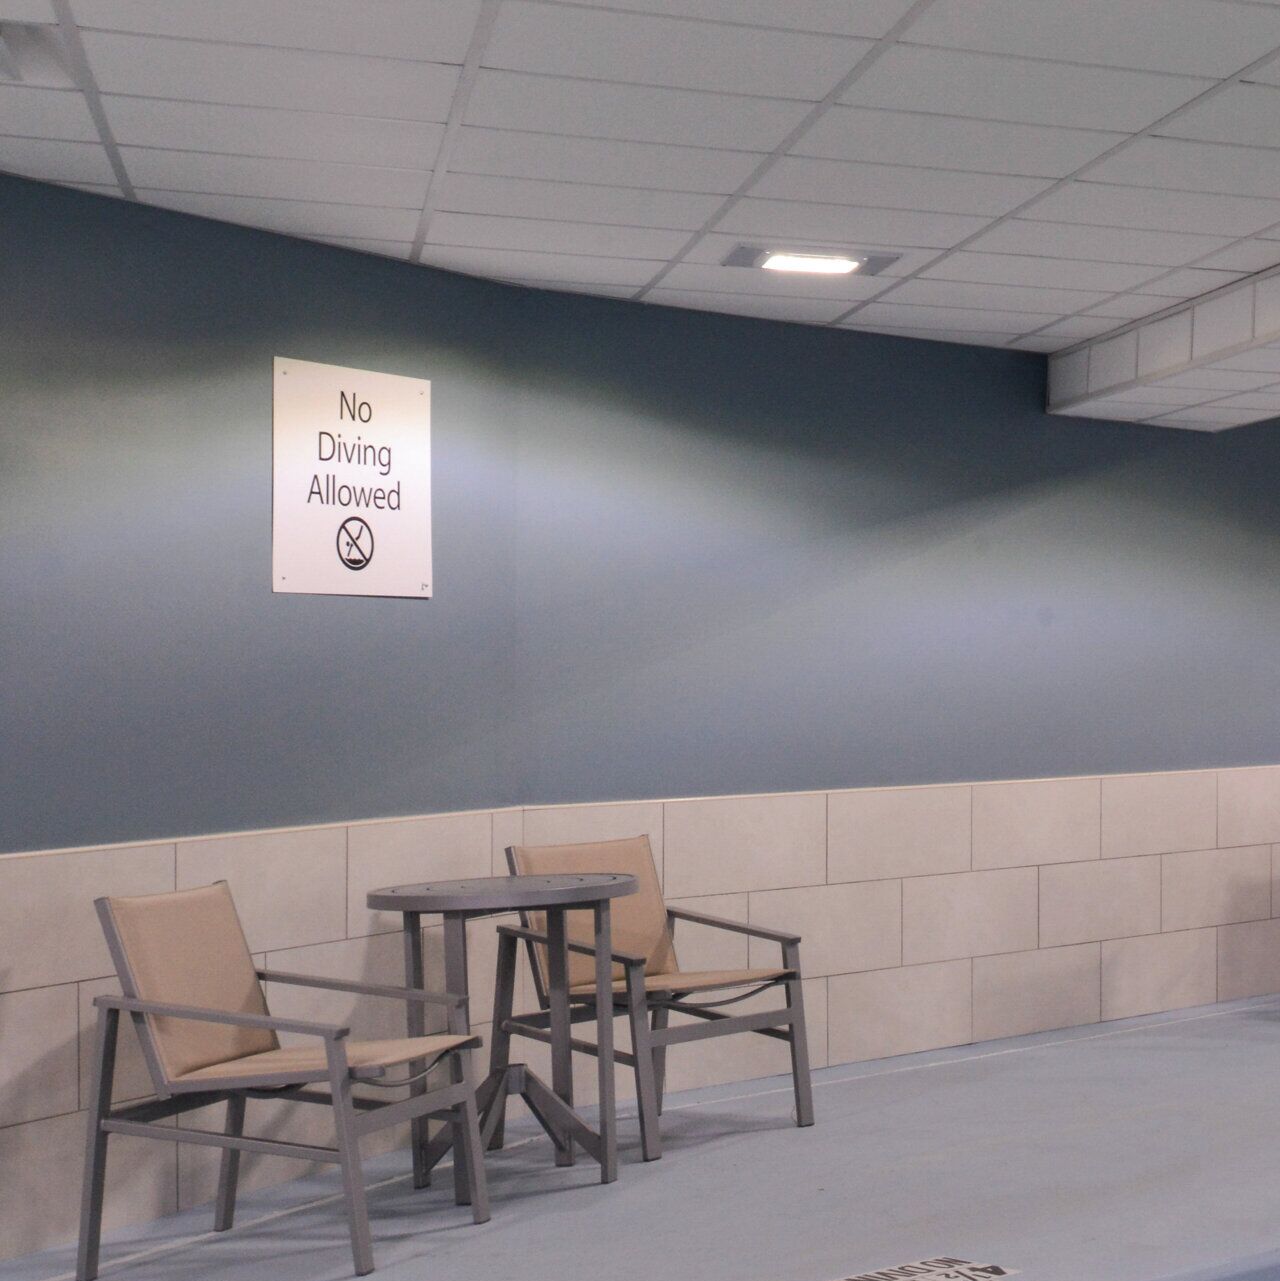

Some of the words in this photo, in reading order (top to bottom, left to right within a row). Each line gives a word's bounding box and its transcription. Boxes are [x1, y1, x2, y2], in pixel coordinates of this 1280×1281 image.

[339, 390, 373, 423] No
[318, 431, 392, 476] Diving
[307, 474, 401, 511] Allowed
[919, 1257, 972, 1268] NO
